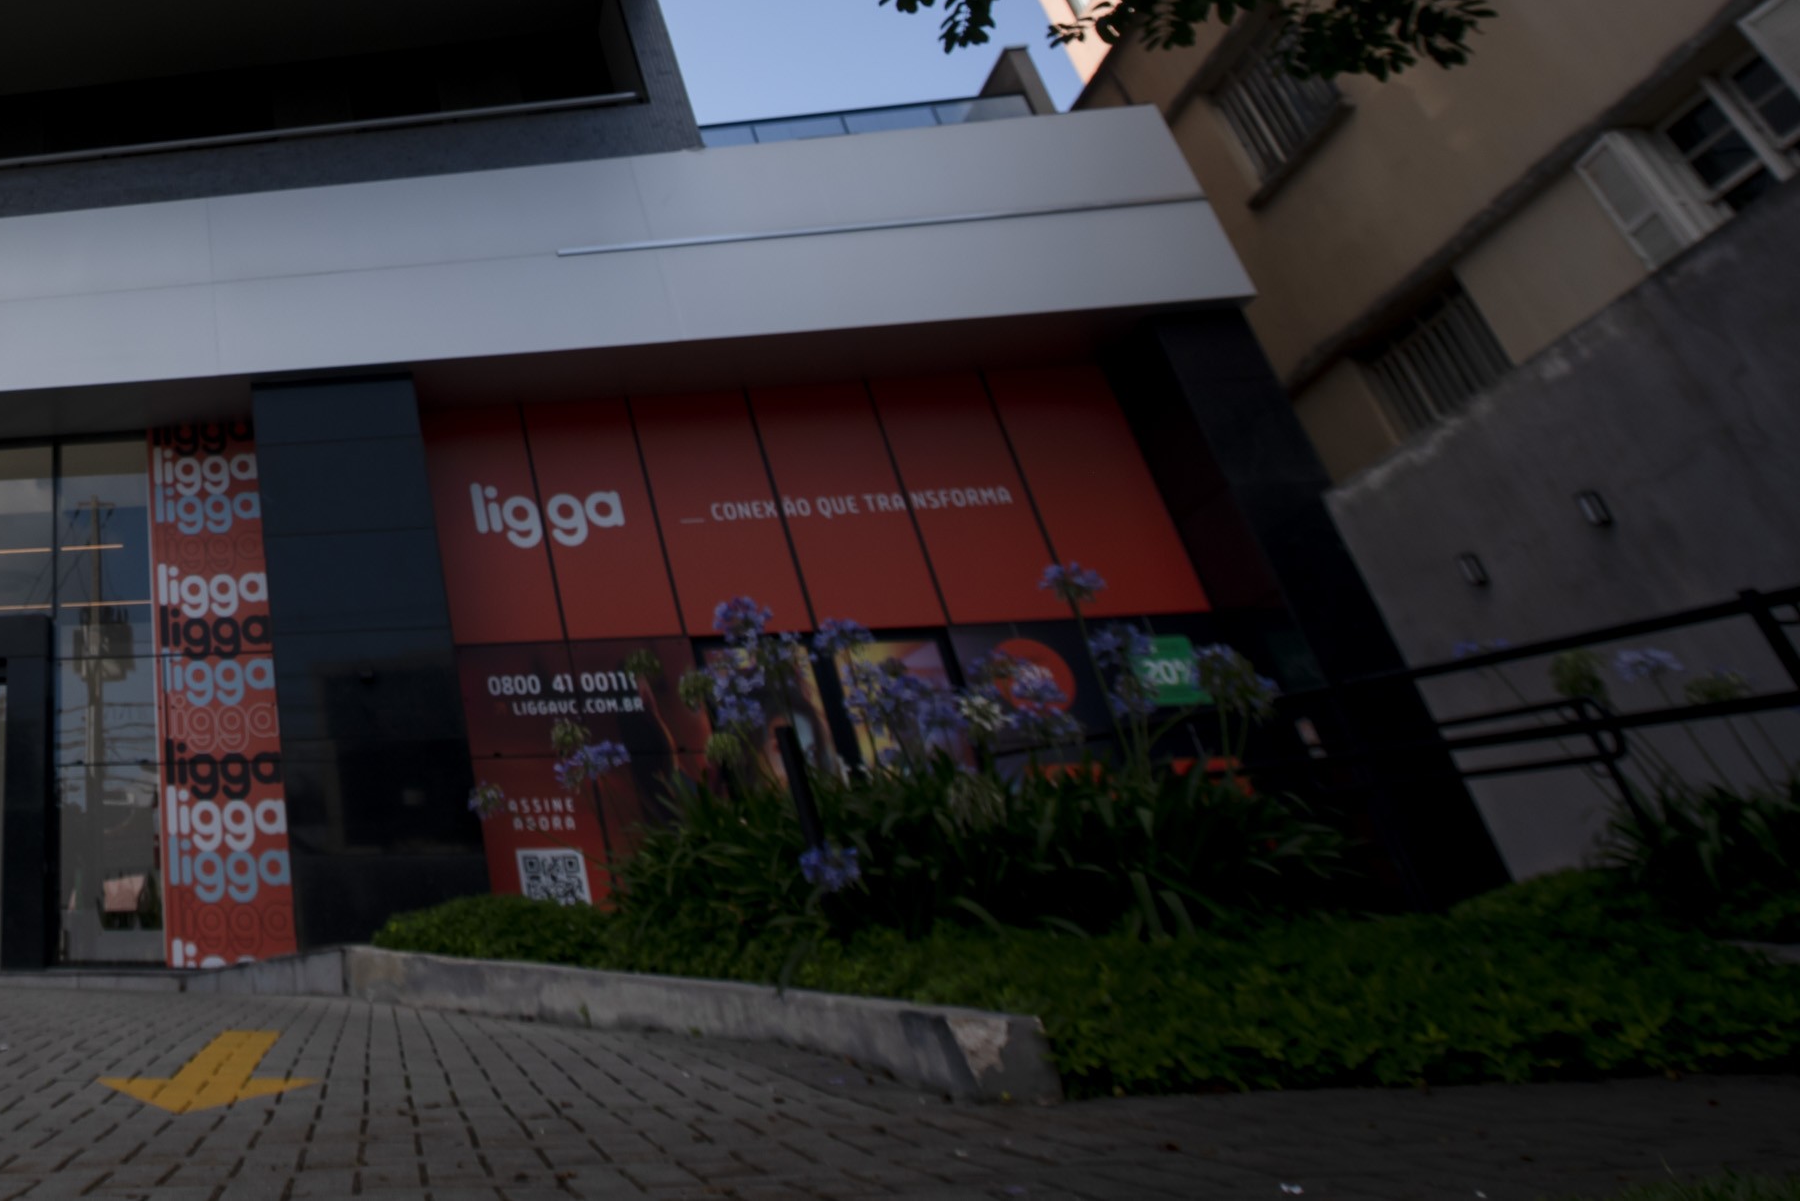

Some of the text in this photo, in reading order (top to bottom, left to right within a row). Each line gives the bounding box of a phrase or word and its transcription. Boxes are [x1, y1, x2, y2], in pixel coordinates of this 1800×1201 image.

[153, 447, 258, 496] ligga
[155, 483, 261, 535] ligga
[469, 482, 625, 549] ligga
[816, 494, 859, 519] QUE
[862, 486, 1014, 514] TRANSFORMA
[157, 563, 268, 618] ligga
[160, 605, 272, 660] ligga
[161, 647, 275, 706] ligga
[487, 674, 541, 696] 0800
[551, 673, 574, 693] 41
[164, 692, 279, 753] ligga
[166, 738, 282, 799] ligga
[166, 785, 287, 852] ligga
[508, 797, 575, 814] ASSINE
[512, 815, 576, 831] AGORA
[169, 835, 292, 904] ligga
